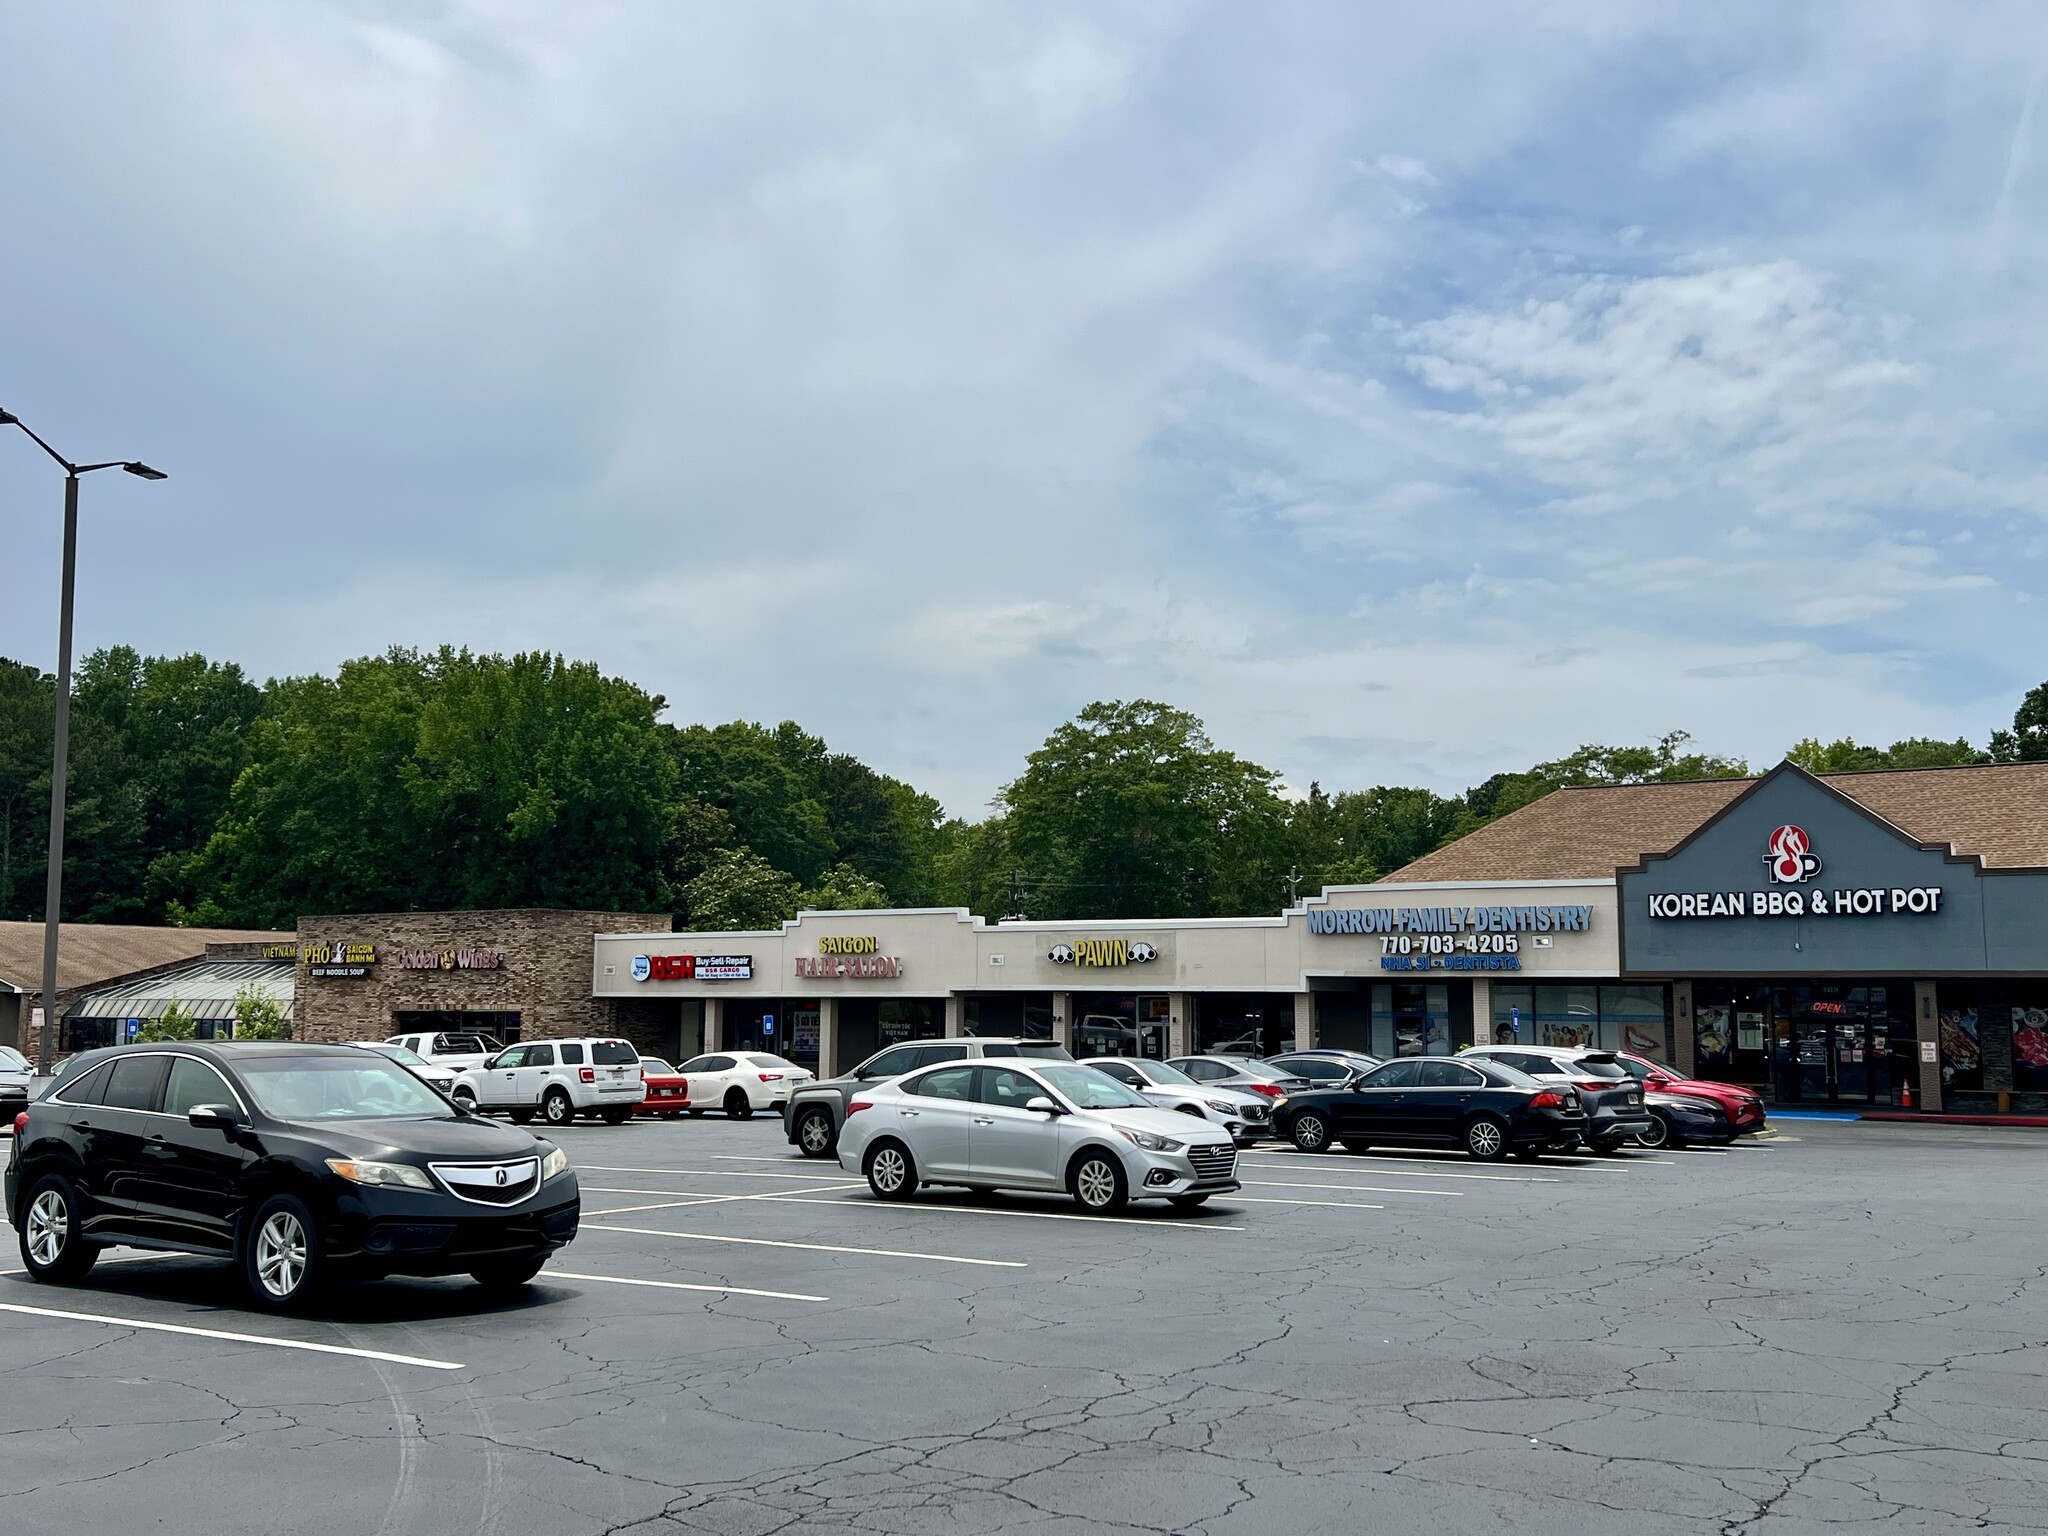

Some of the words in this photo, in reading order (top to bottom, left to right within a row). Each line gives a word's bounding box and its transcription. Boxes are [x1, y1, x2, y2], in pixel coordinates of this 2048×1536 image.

[1762, 853, 1822, 884] TOP
[1649, 893, 1745, 917] KOREAN
[1753, 891, 1804, 915] BBQ
[1811, 889, 1828, 914] &
[1834, 889, 1885, 913] HOT
[1892, 888, 1941, 912] POT
[1307, 907, 1394, 934] MORROW
[1398, 906, 1469, 932] FAMILY
[1474, 905, 1594, 932] DENTISTRY
[819, 936, 875, 953] SAIGON
[1075, 940, 1128, 967] PAWN
[1379, 934, 1519, 954] 770-703-4205
[398, 949, 438, 969] Golden
[457, 948, 499, 969] Wings
[651, 956, 695, 979] BSR
[795, 957, 839, 977] HAIR
[844, 956, 901, 977] SALON
[1380, 956, 1411, 970] NHA
[1443, 955, 1520, 969] DENTISTA
[326, 968, 348, 976] NOODLE
[349, 968, 365, 976] SOUP
[1813, 1002, 1841, 1013] OPEN
